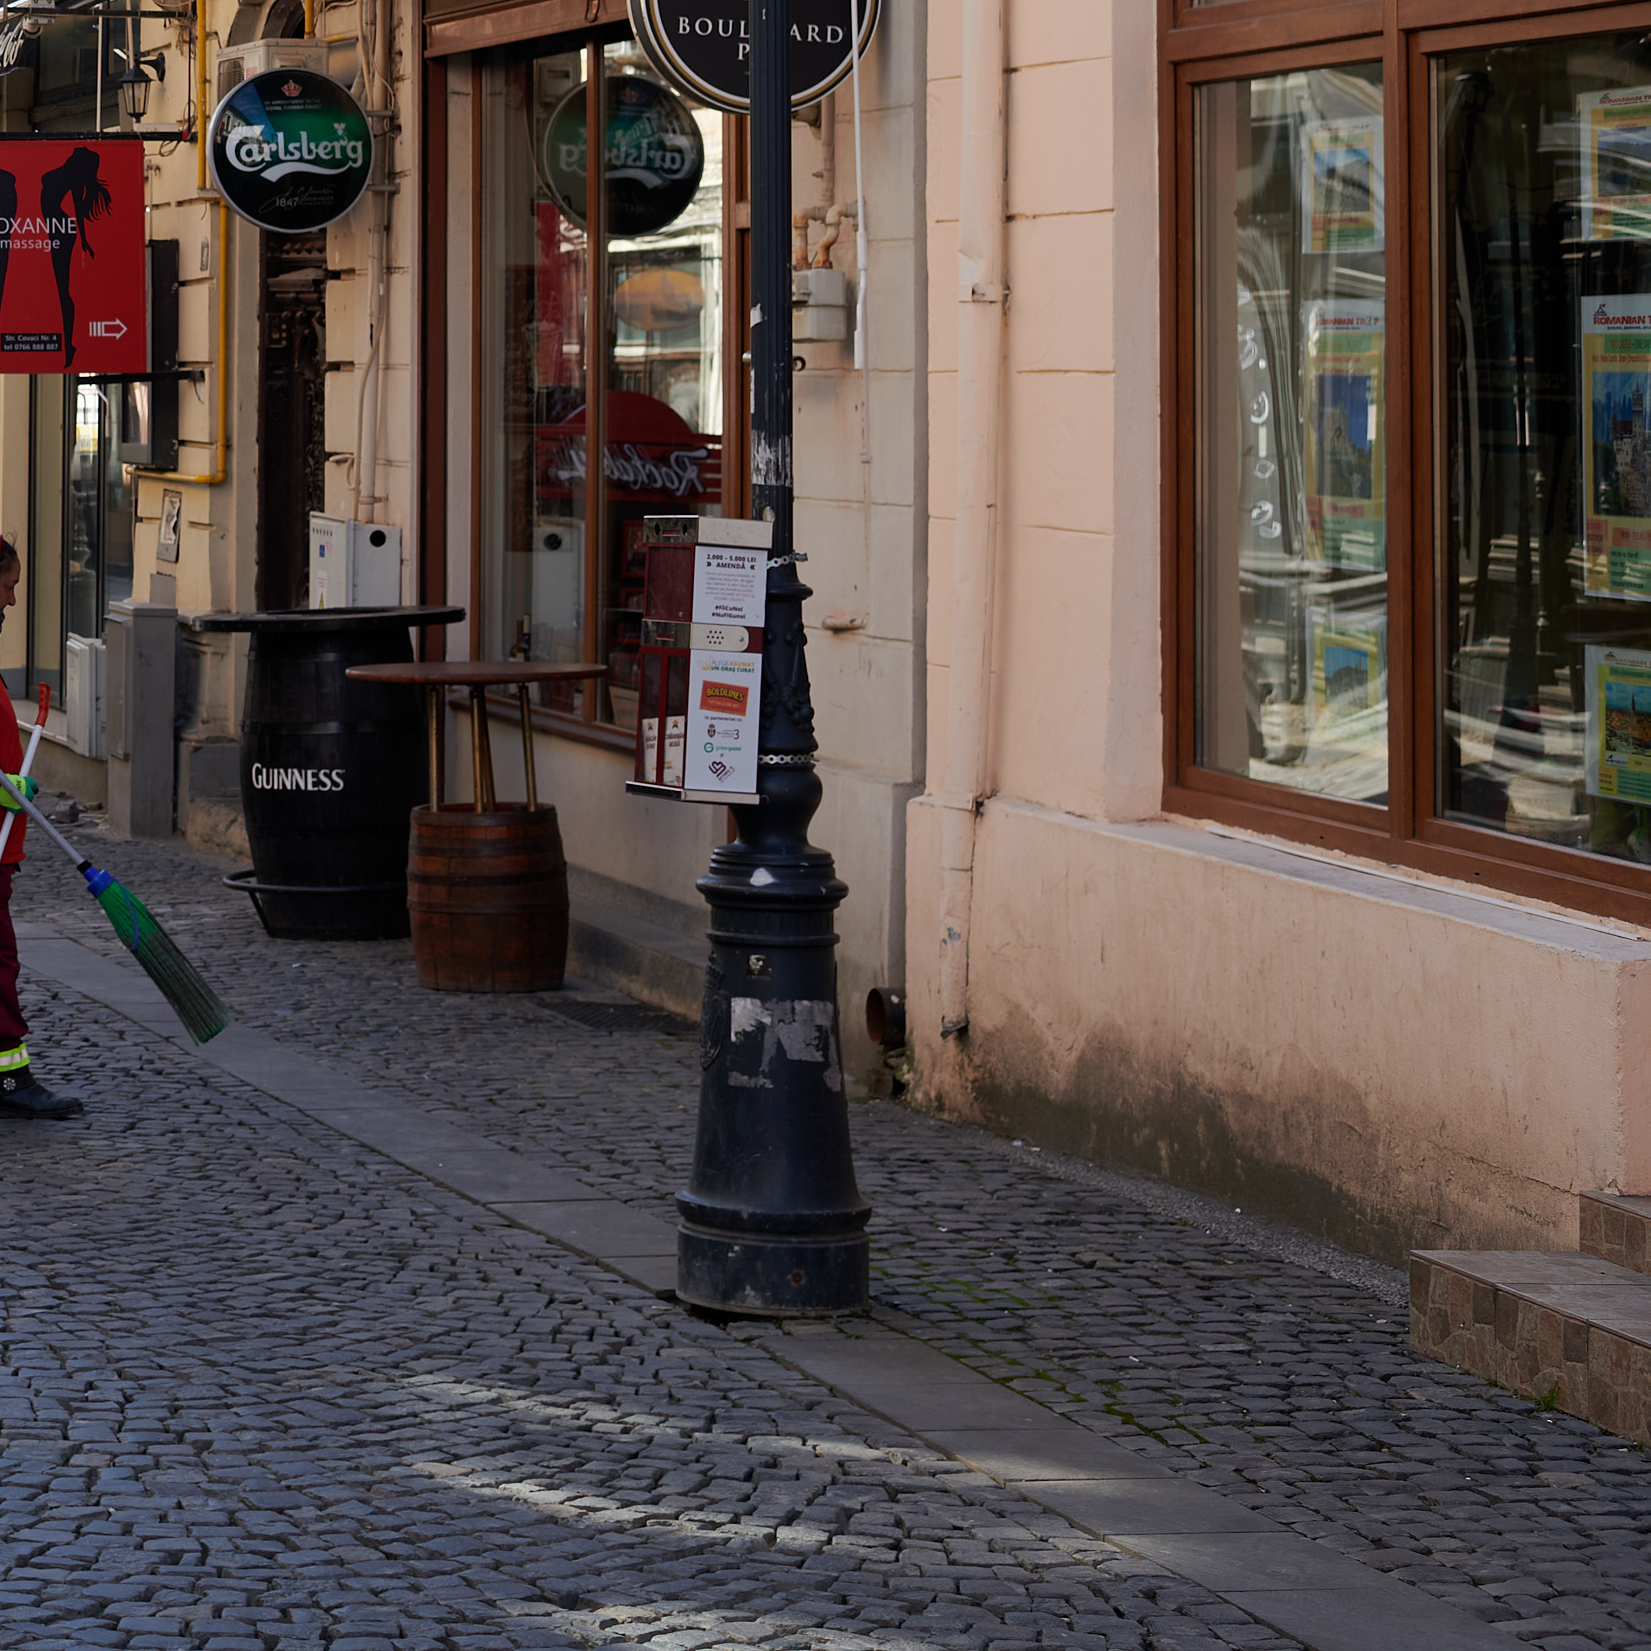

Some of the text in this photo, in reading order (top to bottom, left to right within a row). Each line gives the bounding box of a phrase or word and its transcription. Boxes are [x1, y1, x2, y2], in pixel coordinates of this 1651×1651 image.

[678, 16, 844, 44] BOULARD
[225, 123, 363, 173] Carlsberg
[276, 197, 298, 207] 1847
[0, 239, 61, 252] massage
[1593, 315, 1646, 325] ROMANIAN
[17, 334, 39, 342] Covaci
[251, 762, 344, 791] GUINNESS
